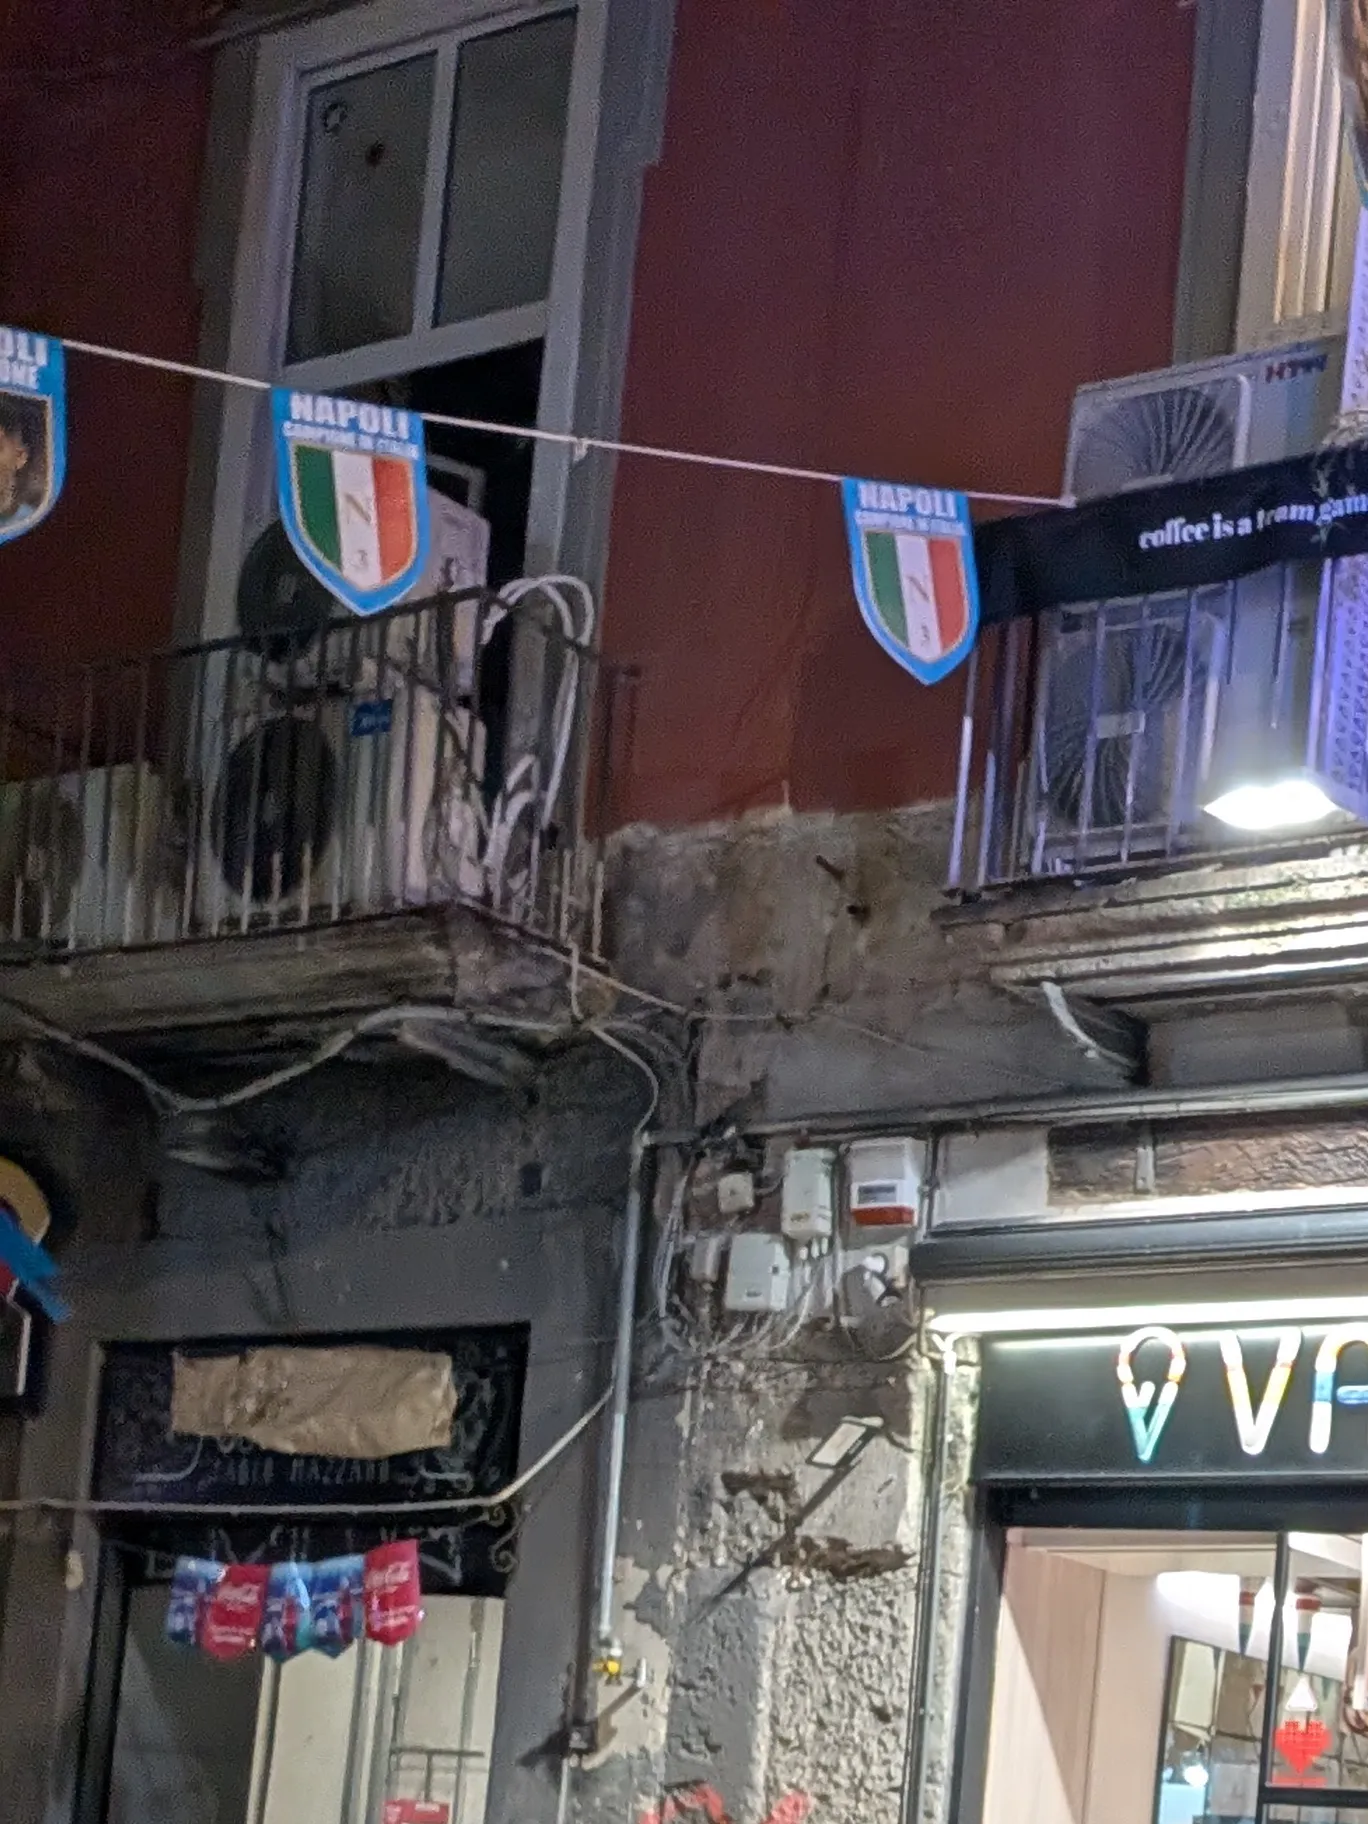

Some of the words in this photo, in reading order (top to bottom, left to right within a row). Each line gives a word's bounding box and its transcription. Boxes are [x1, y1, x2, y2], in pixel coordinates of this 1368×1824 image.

[290, 391, 410, 440] NAPOLI
[859, 482, 957, 519] NAPOLI
[1138, 516, 1210, 550] coffee
[1212, 511, 1235, 540] is
[1237, 516, 1252, 537] a
